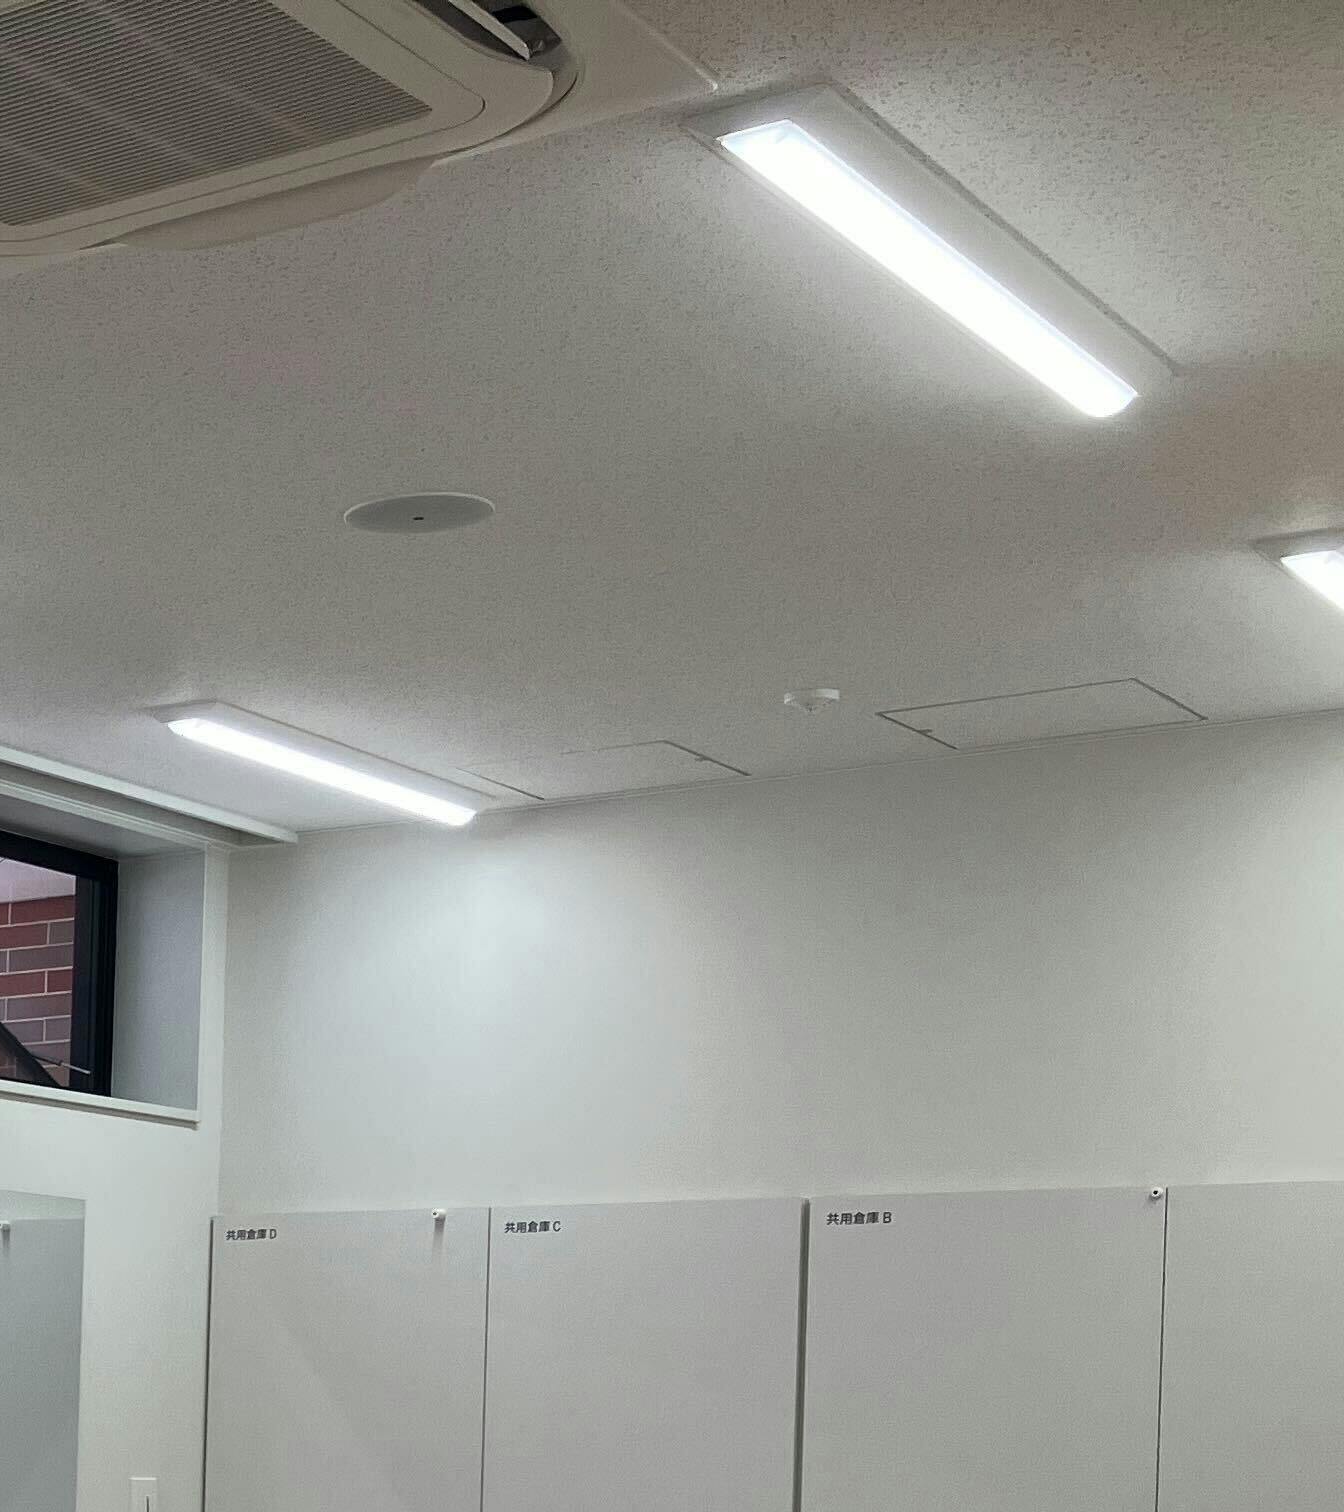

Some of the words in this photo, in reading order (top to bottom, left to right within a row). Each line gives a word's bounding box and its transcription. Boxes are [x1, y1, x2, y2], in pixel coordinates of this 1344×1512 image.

[825, 1211, 880, 1225] 共用倉庫
[882, 1211, 892, 1224] B
[504, 1221, 551, 1233] 共用倉庫
[552, 1221, 562, 1232] C
[269, 1229, 277, 1240] D
